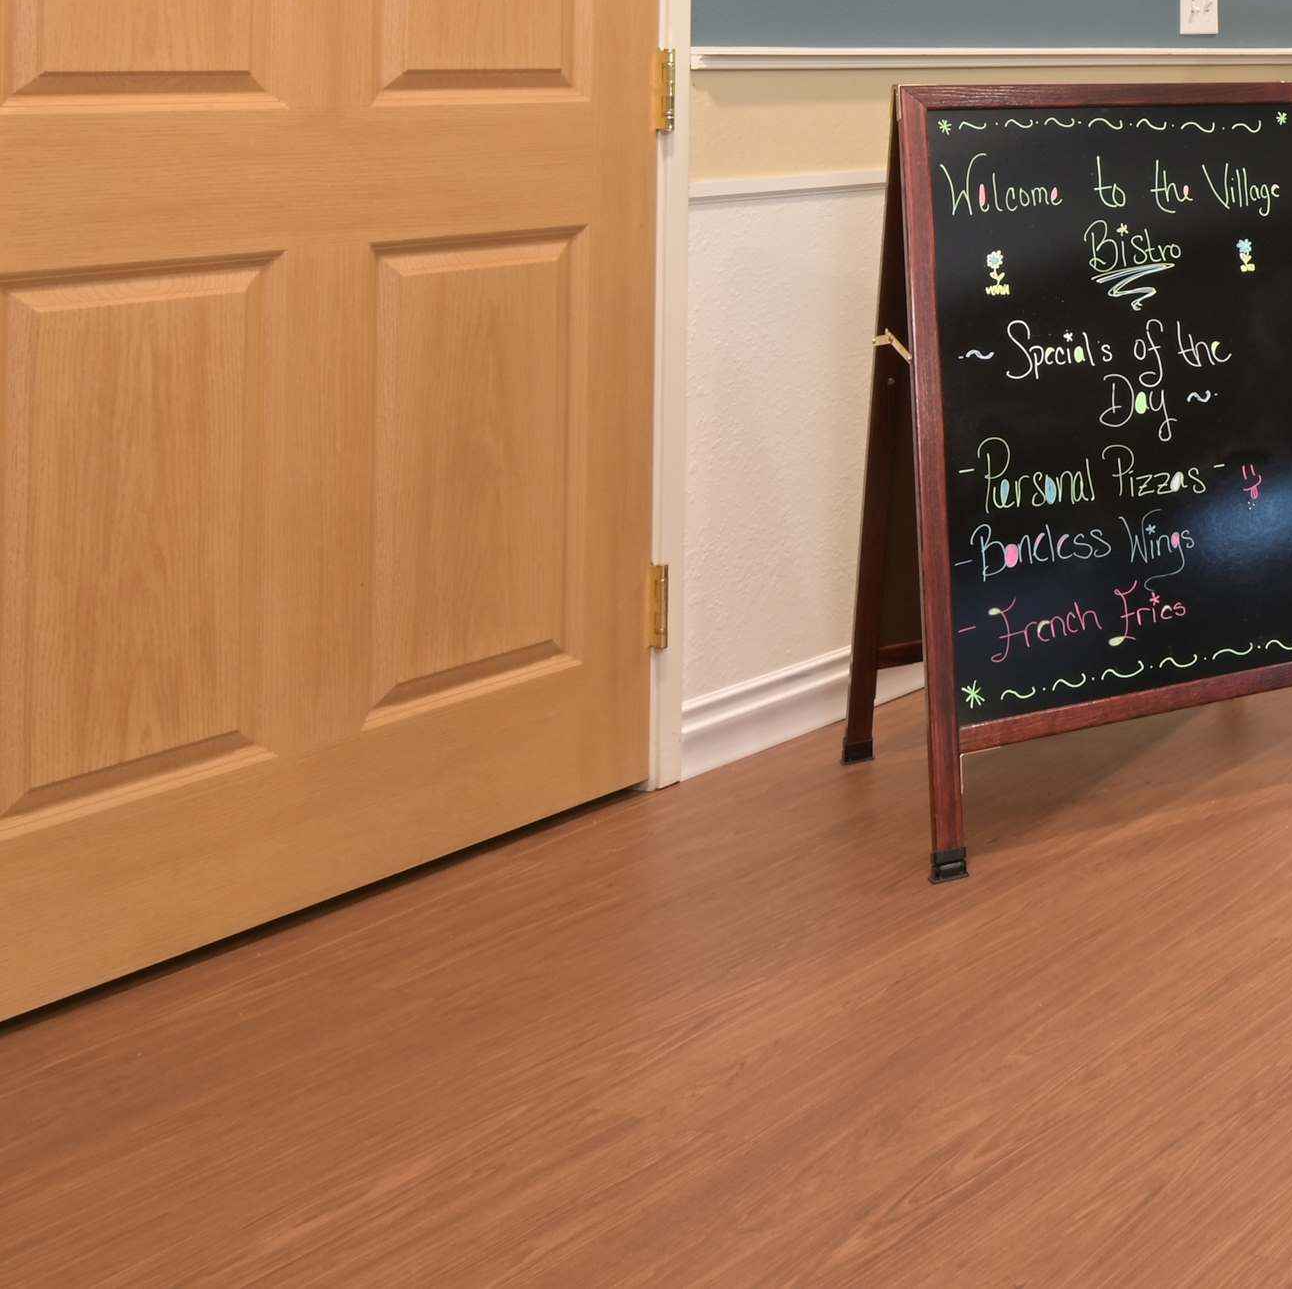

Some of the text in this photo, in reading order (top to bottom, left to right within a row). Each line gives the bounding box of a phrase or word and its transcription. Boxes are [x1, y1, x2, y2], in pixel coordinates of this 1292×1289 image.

[940, 153, 1280, 216] Welcome to the Village
[1084, 220, 1182, 272] Bistro
[1134, 319, 1163, 387] of
[1176, 321, 1232, 367] the
[1099, 374, 1177, 441] Day
[977, 437, 1207, 514] Personal Pizzas
[970, 509, 1195, 592] Boneless Wings
[988, 580, 1187, 663] French Fries
